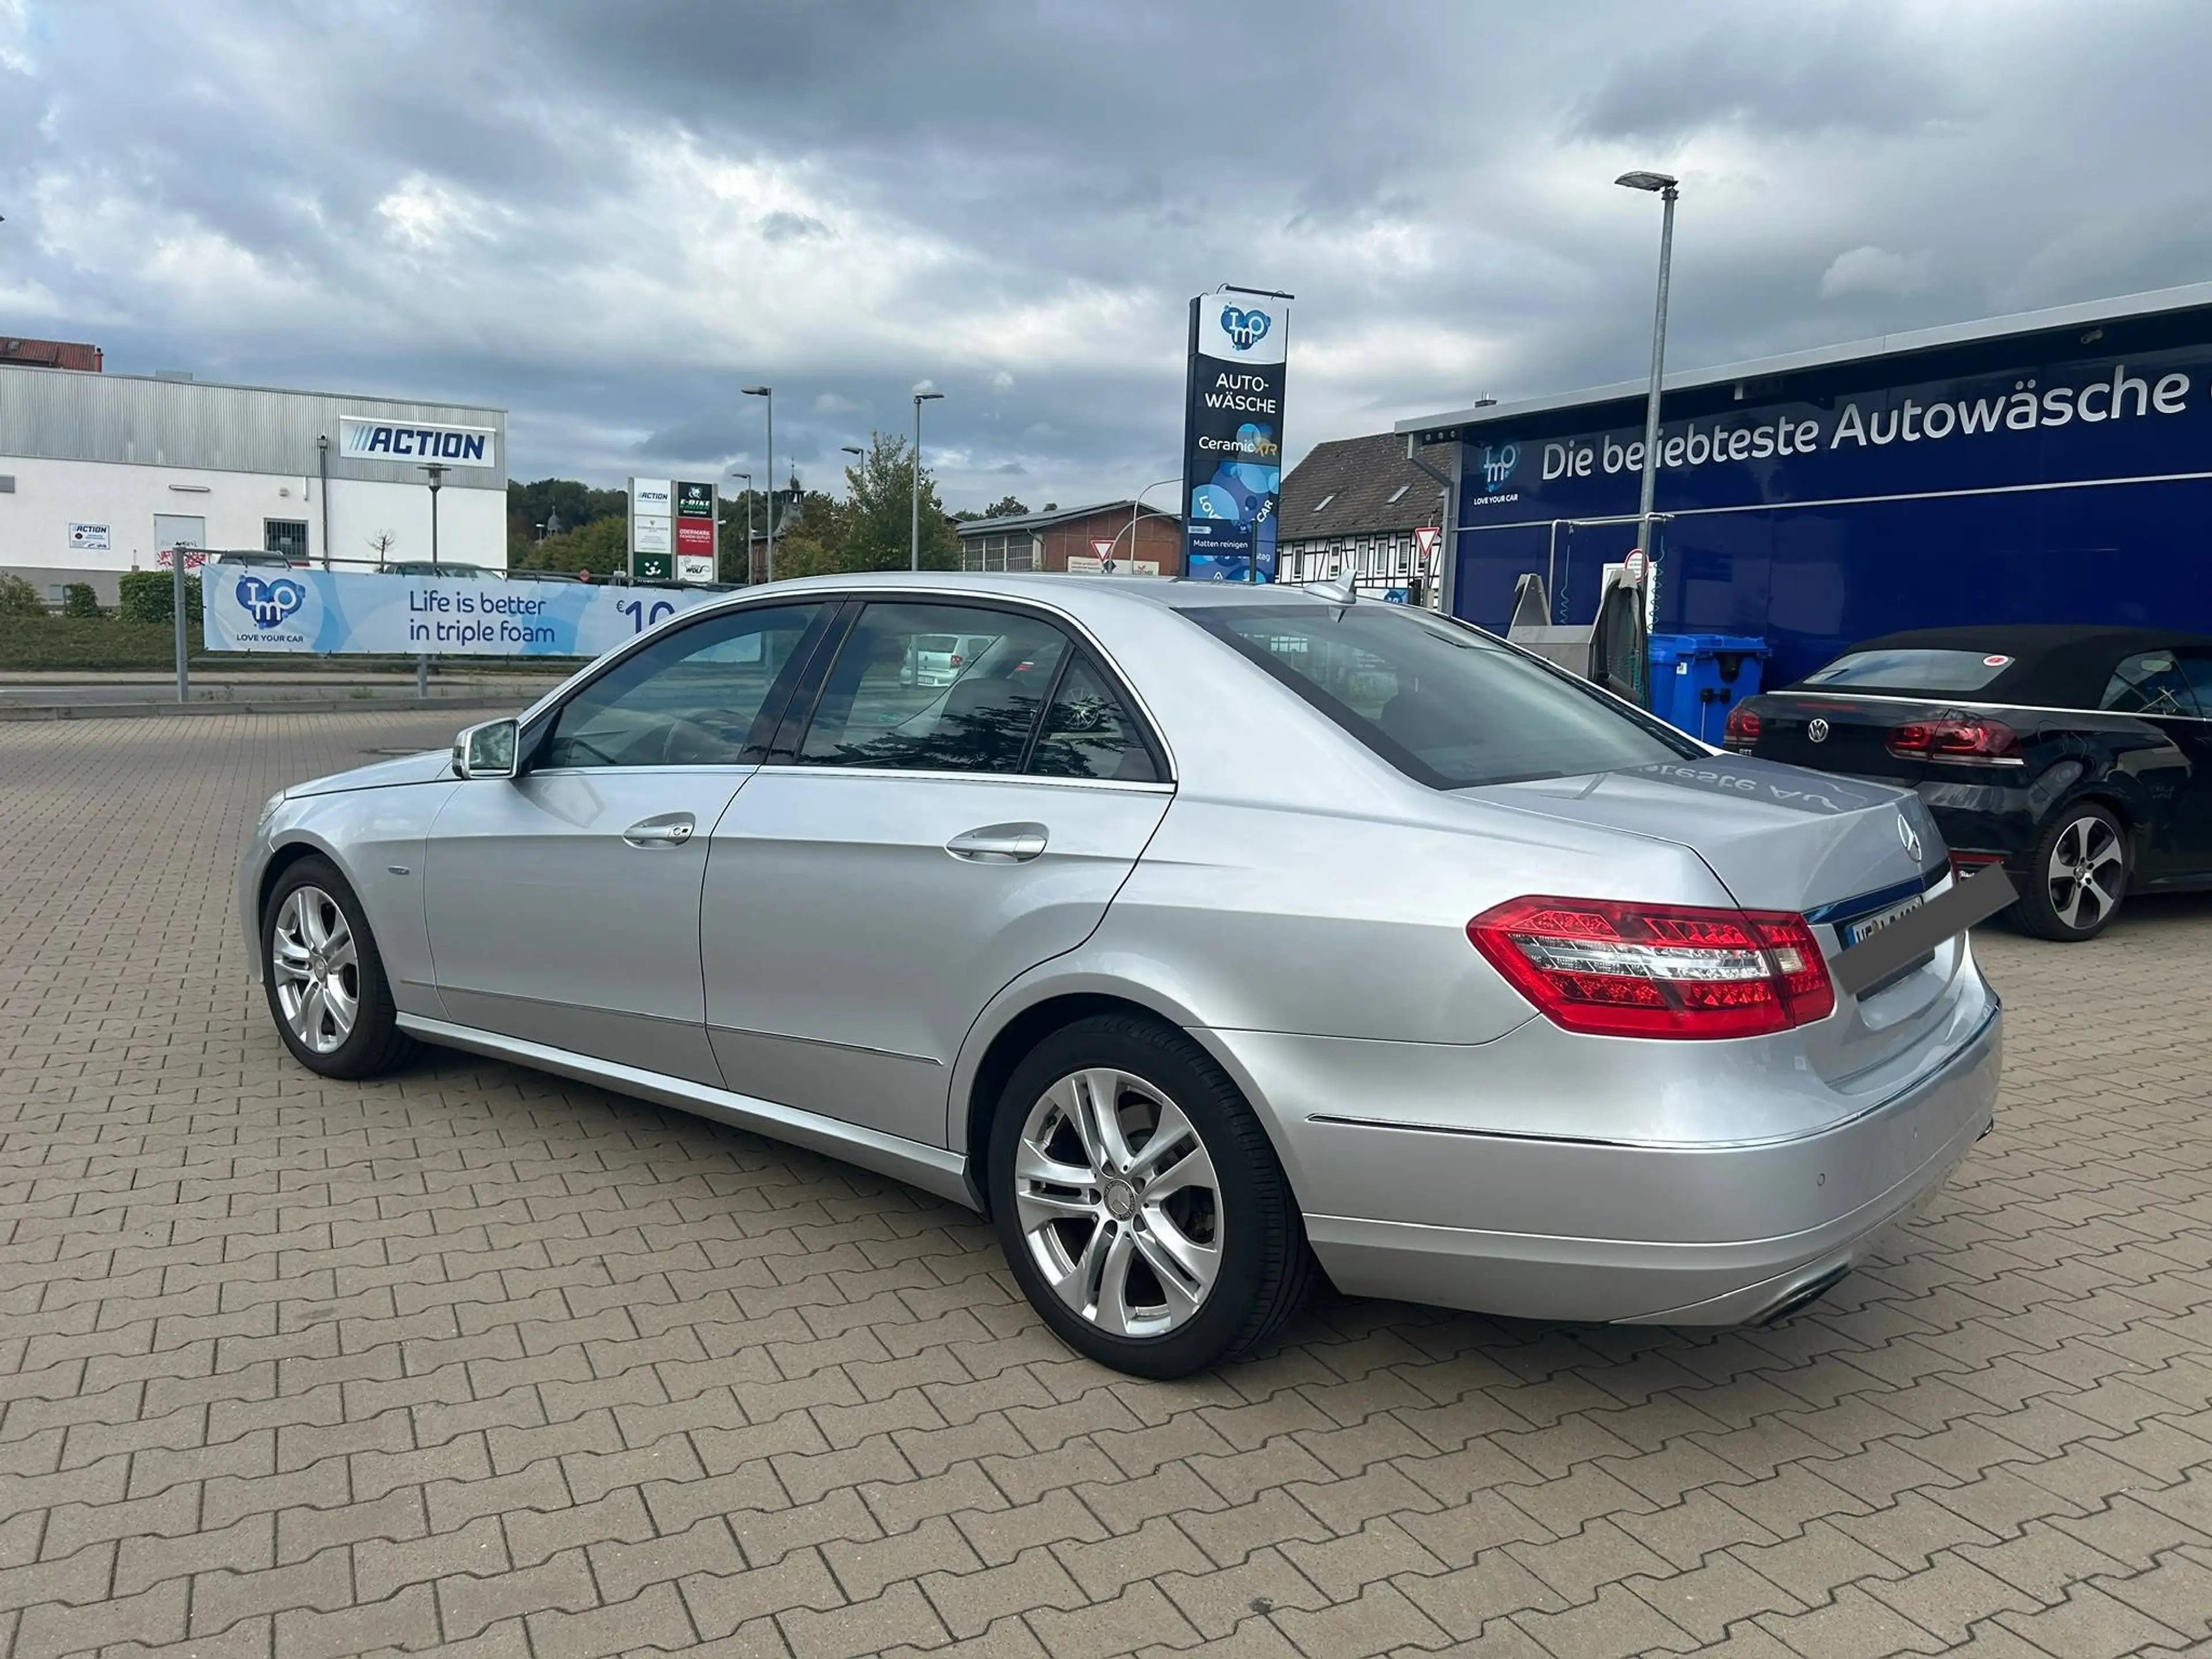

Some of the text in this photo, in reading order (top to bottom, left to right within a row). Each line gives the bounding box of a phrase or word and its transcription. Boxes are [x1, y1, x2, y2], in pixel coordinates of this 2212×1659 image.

[1216, 373, 1269, 392] AUTO-
[1205, 391, 1277, 414] WÄSCHE
[1543, 365, 2190, 480] Die beiebteste Autowäsche
[368, 427, 485, 460] ACTION
[1199, 495, 1273, 523] LOV CAR
[1474, 494, 1518, 505] LOVE YOUR CAR
[1193, 539, 1248, 550] Matten reinigen
[410, 590, 547, 615] Life is better
[410, 619, 555, 646] in triple foam
